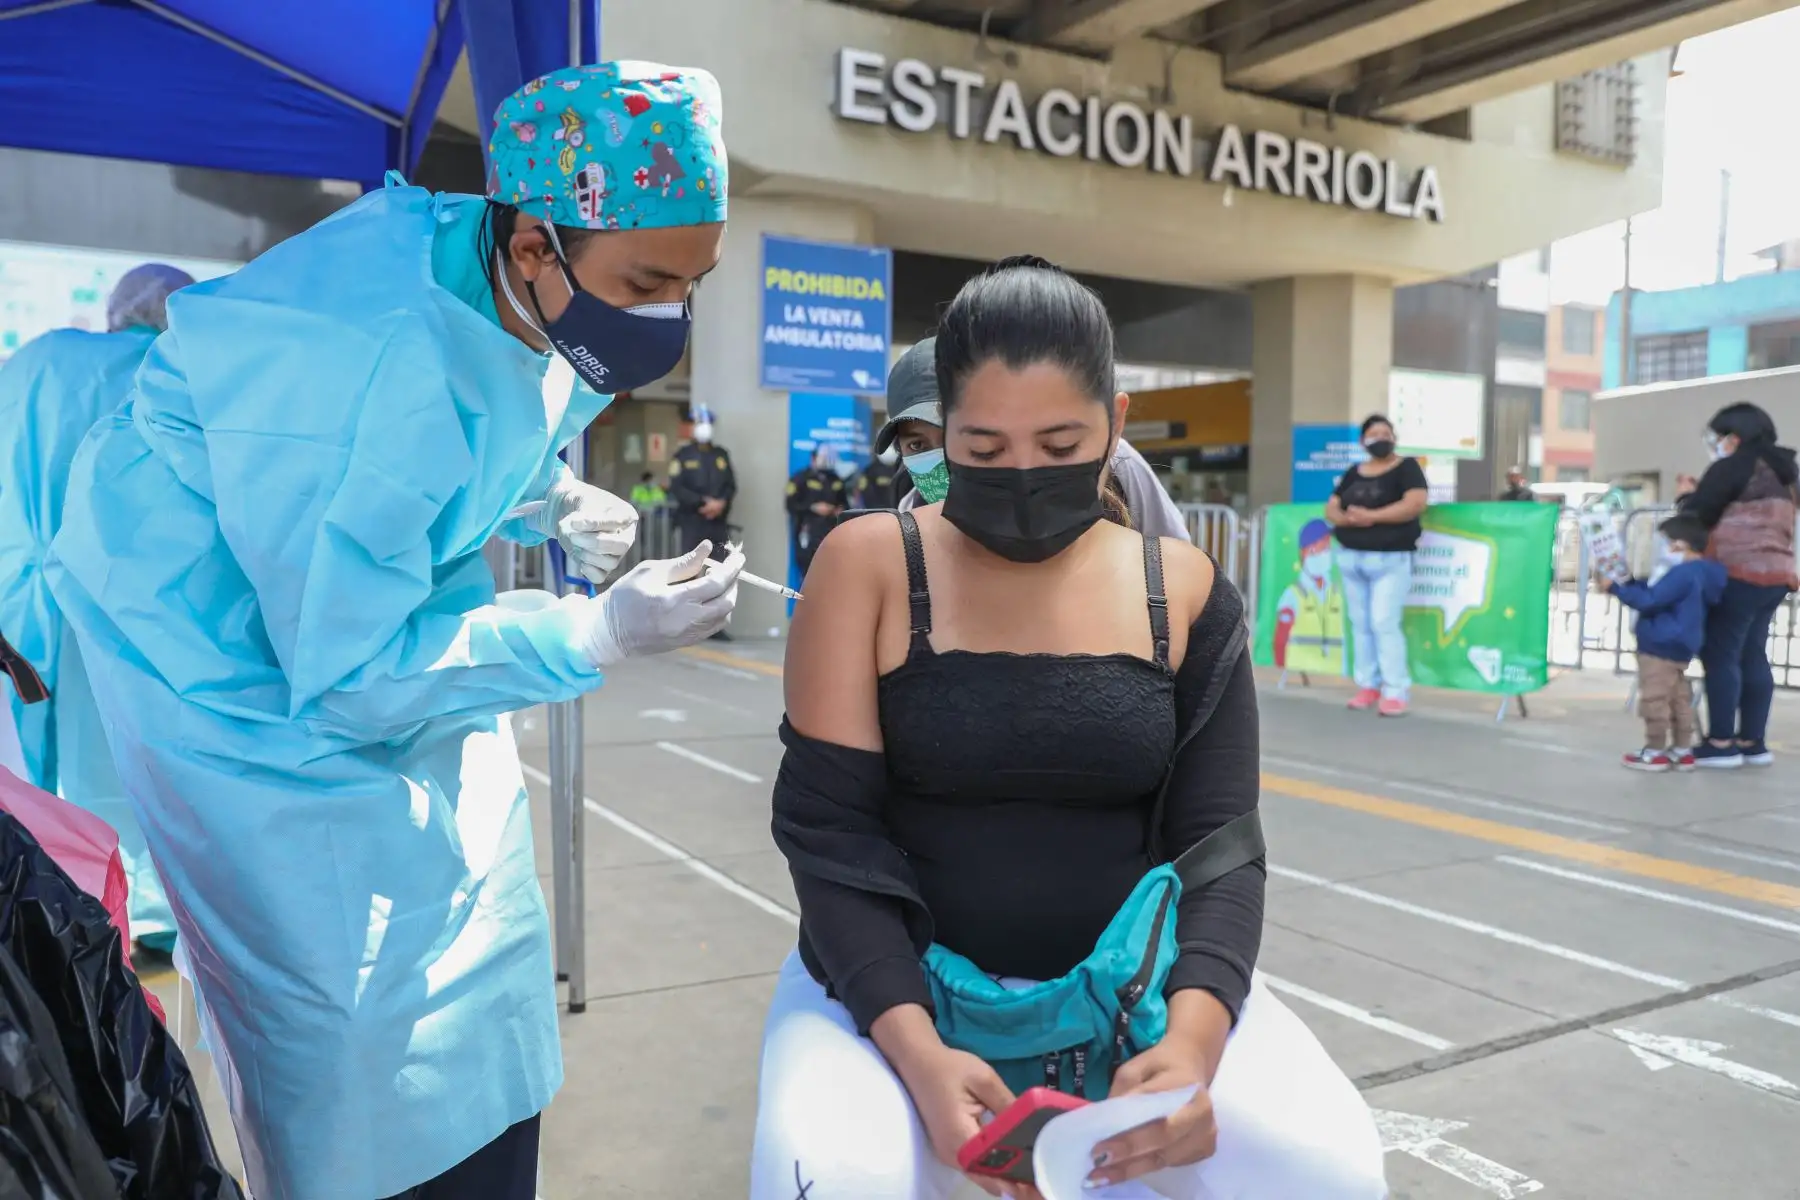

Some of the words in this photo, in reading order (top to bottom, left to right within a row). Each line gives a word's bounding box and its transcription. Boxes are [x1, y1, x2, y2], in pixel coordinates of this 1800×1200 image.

[839, 47, 1193, 176] ESTACION
[1210, 124, 1445, 223] ARRIOLA
[765, 266, 885, 301] PROHIBIDA
[784, 303, 807, 324] LA
[808, 305, 865, 330] VENTA
[764, 324, 884, 352] AMBULATORIA
[556, 340, 577, 360] Lima
[576, 361, 604, 384] Centro
[572, 345, 609, 376] DIRIS
